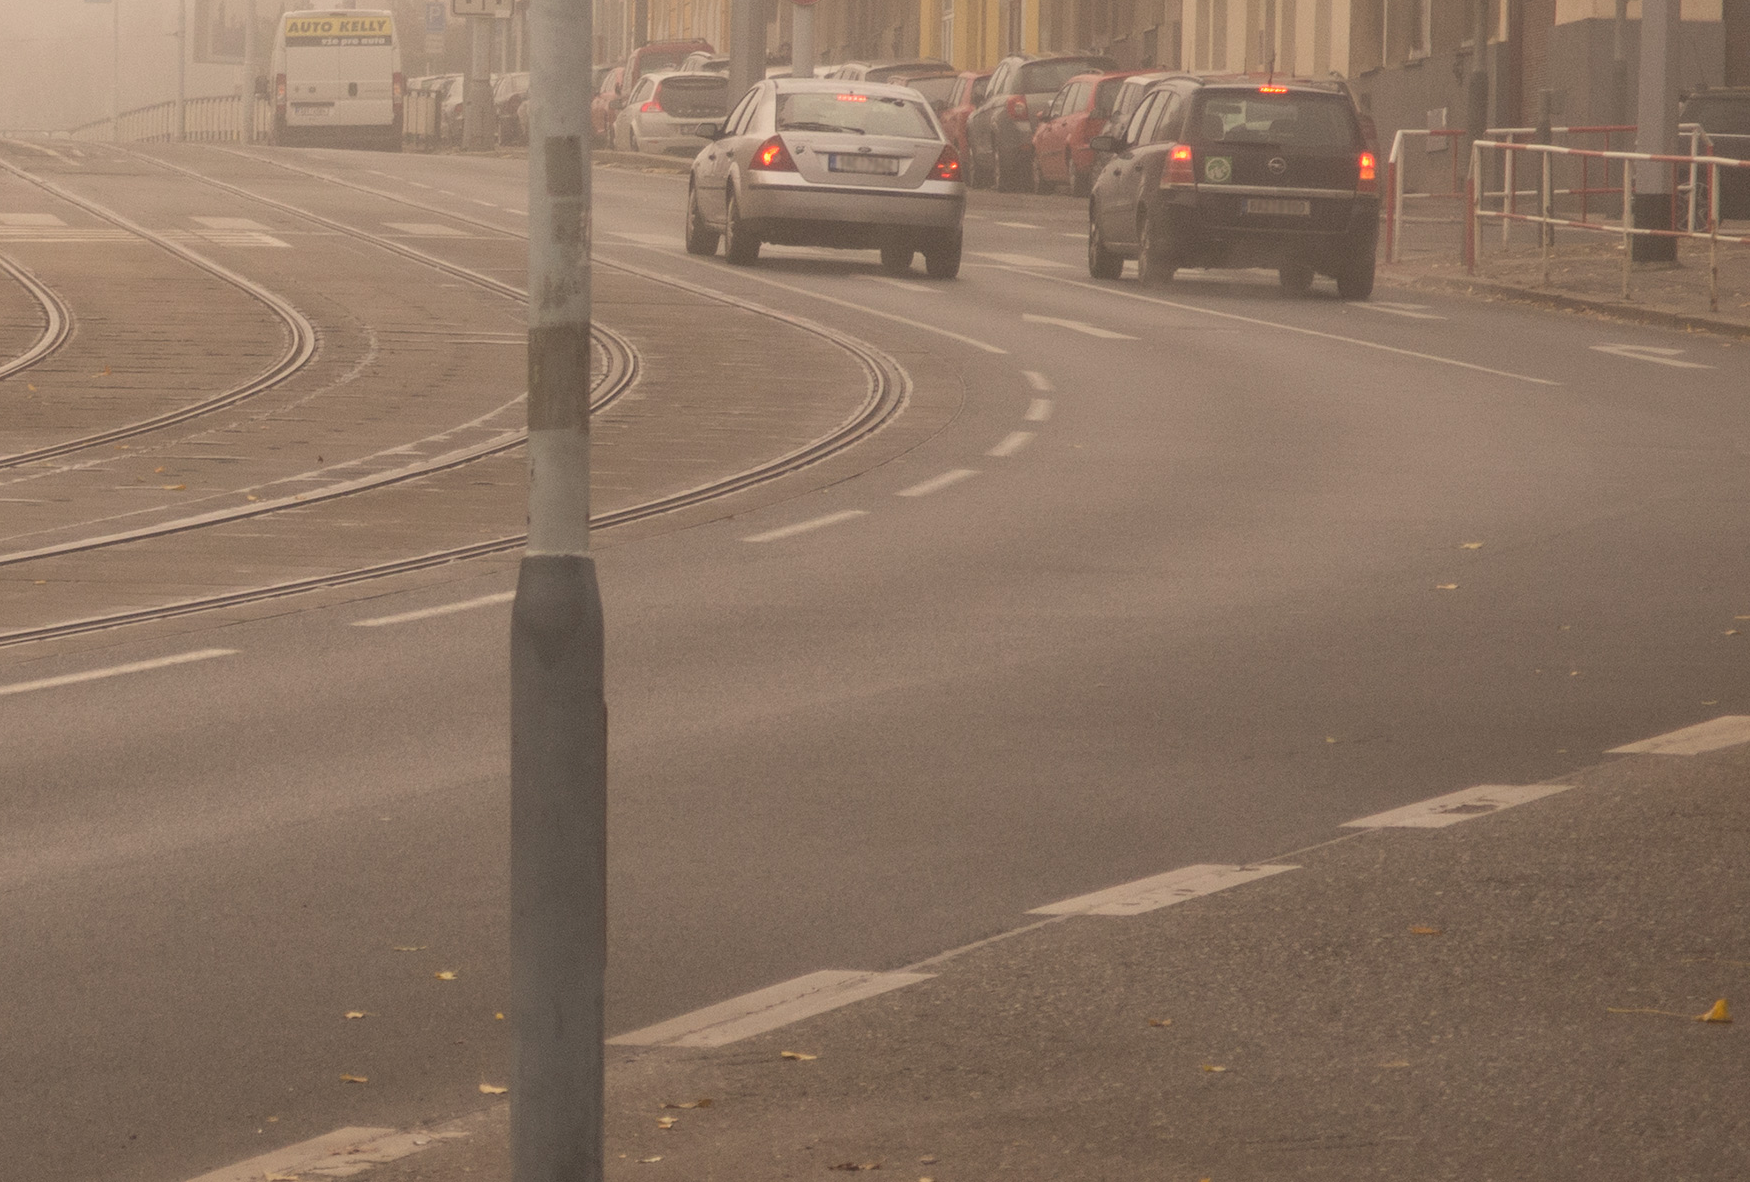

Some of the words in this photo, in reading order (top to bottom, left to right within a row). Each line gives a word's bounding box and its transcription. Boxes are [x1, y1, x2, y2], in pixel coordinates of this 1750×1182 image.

[288, 21, 333, 34] AUTO
[339, 20, 387, 32] KELLY
[340, 37, 359, 46] pro
[360, 36, 385, 45] auto
